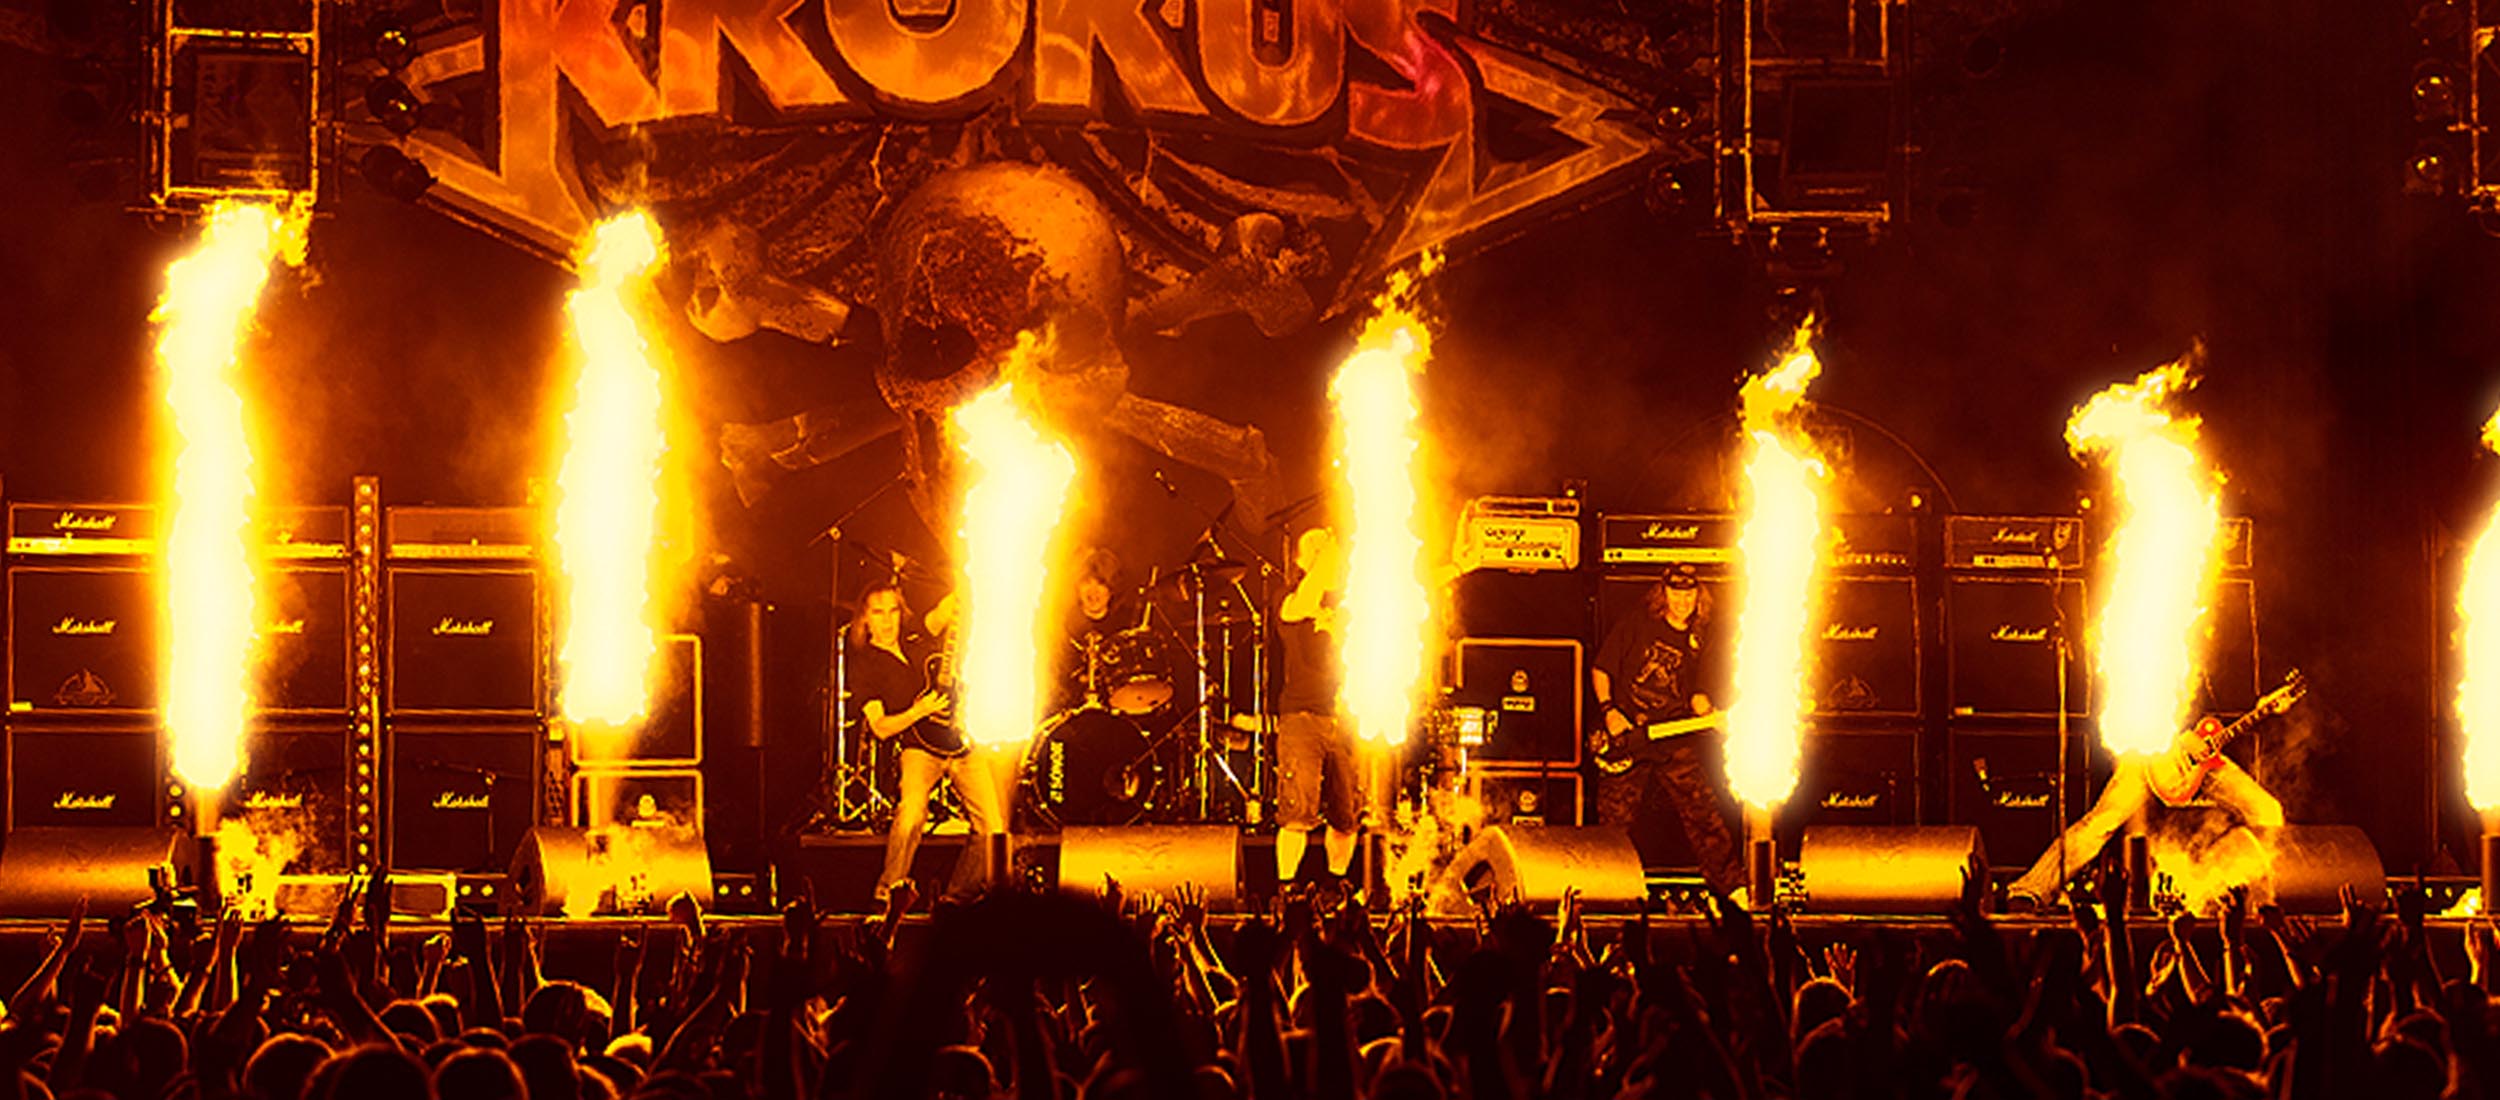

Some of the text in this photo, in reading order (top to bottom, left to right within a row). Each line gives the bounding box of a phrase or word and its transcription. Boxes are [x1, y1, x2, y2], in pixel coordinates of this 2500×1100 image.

[54, 512, 115, 529] Marshall
[1641, 522, 1699, 539] Marshall
[53, 617, 116, 634] Marshall
[432, 617, 493, 635] Marshall
[1821, 623, 1878, 640] Marshall
[1991, 625, 2047, 640] Marshall
[1050, 741, 1064, 789] SONOR
[53, 791, 115, 808] Marshall
[1821, 792, 1878, 808] Marshall
[1993, 791, 2049, 808] Marshall
